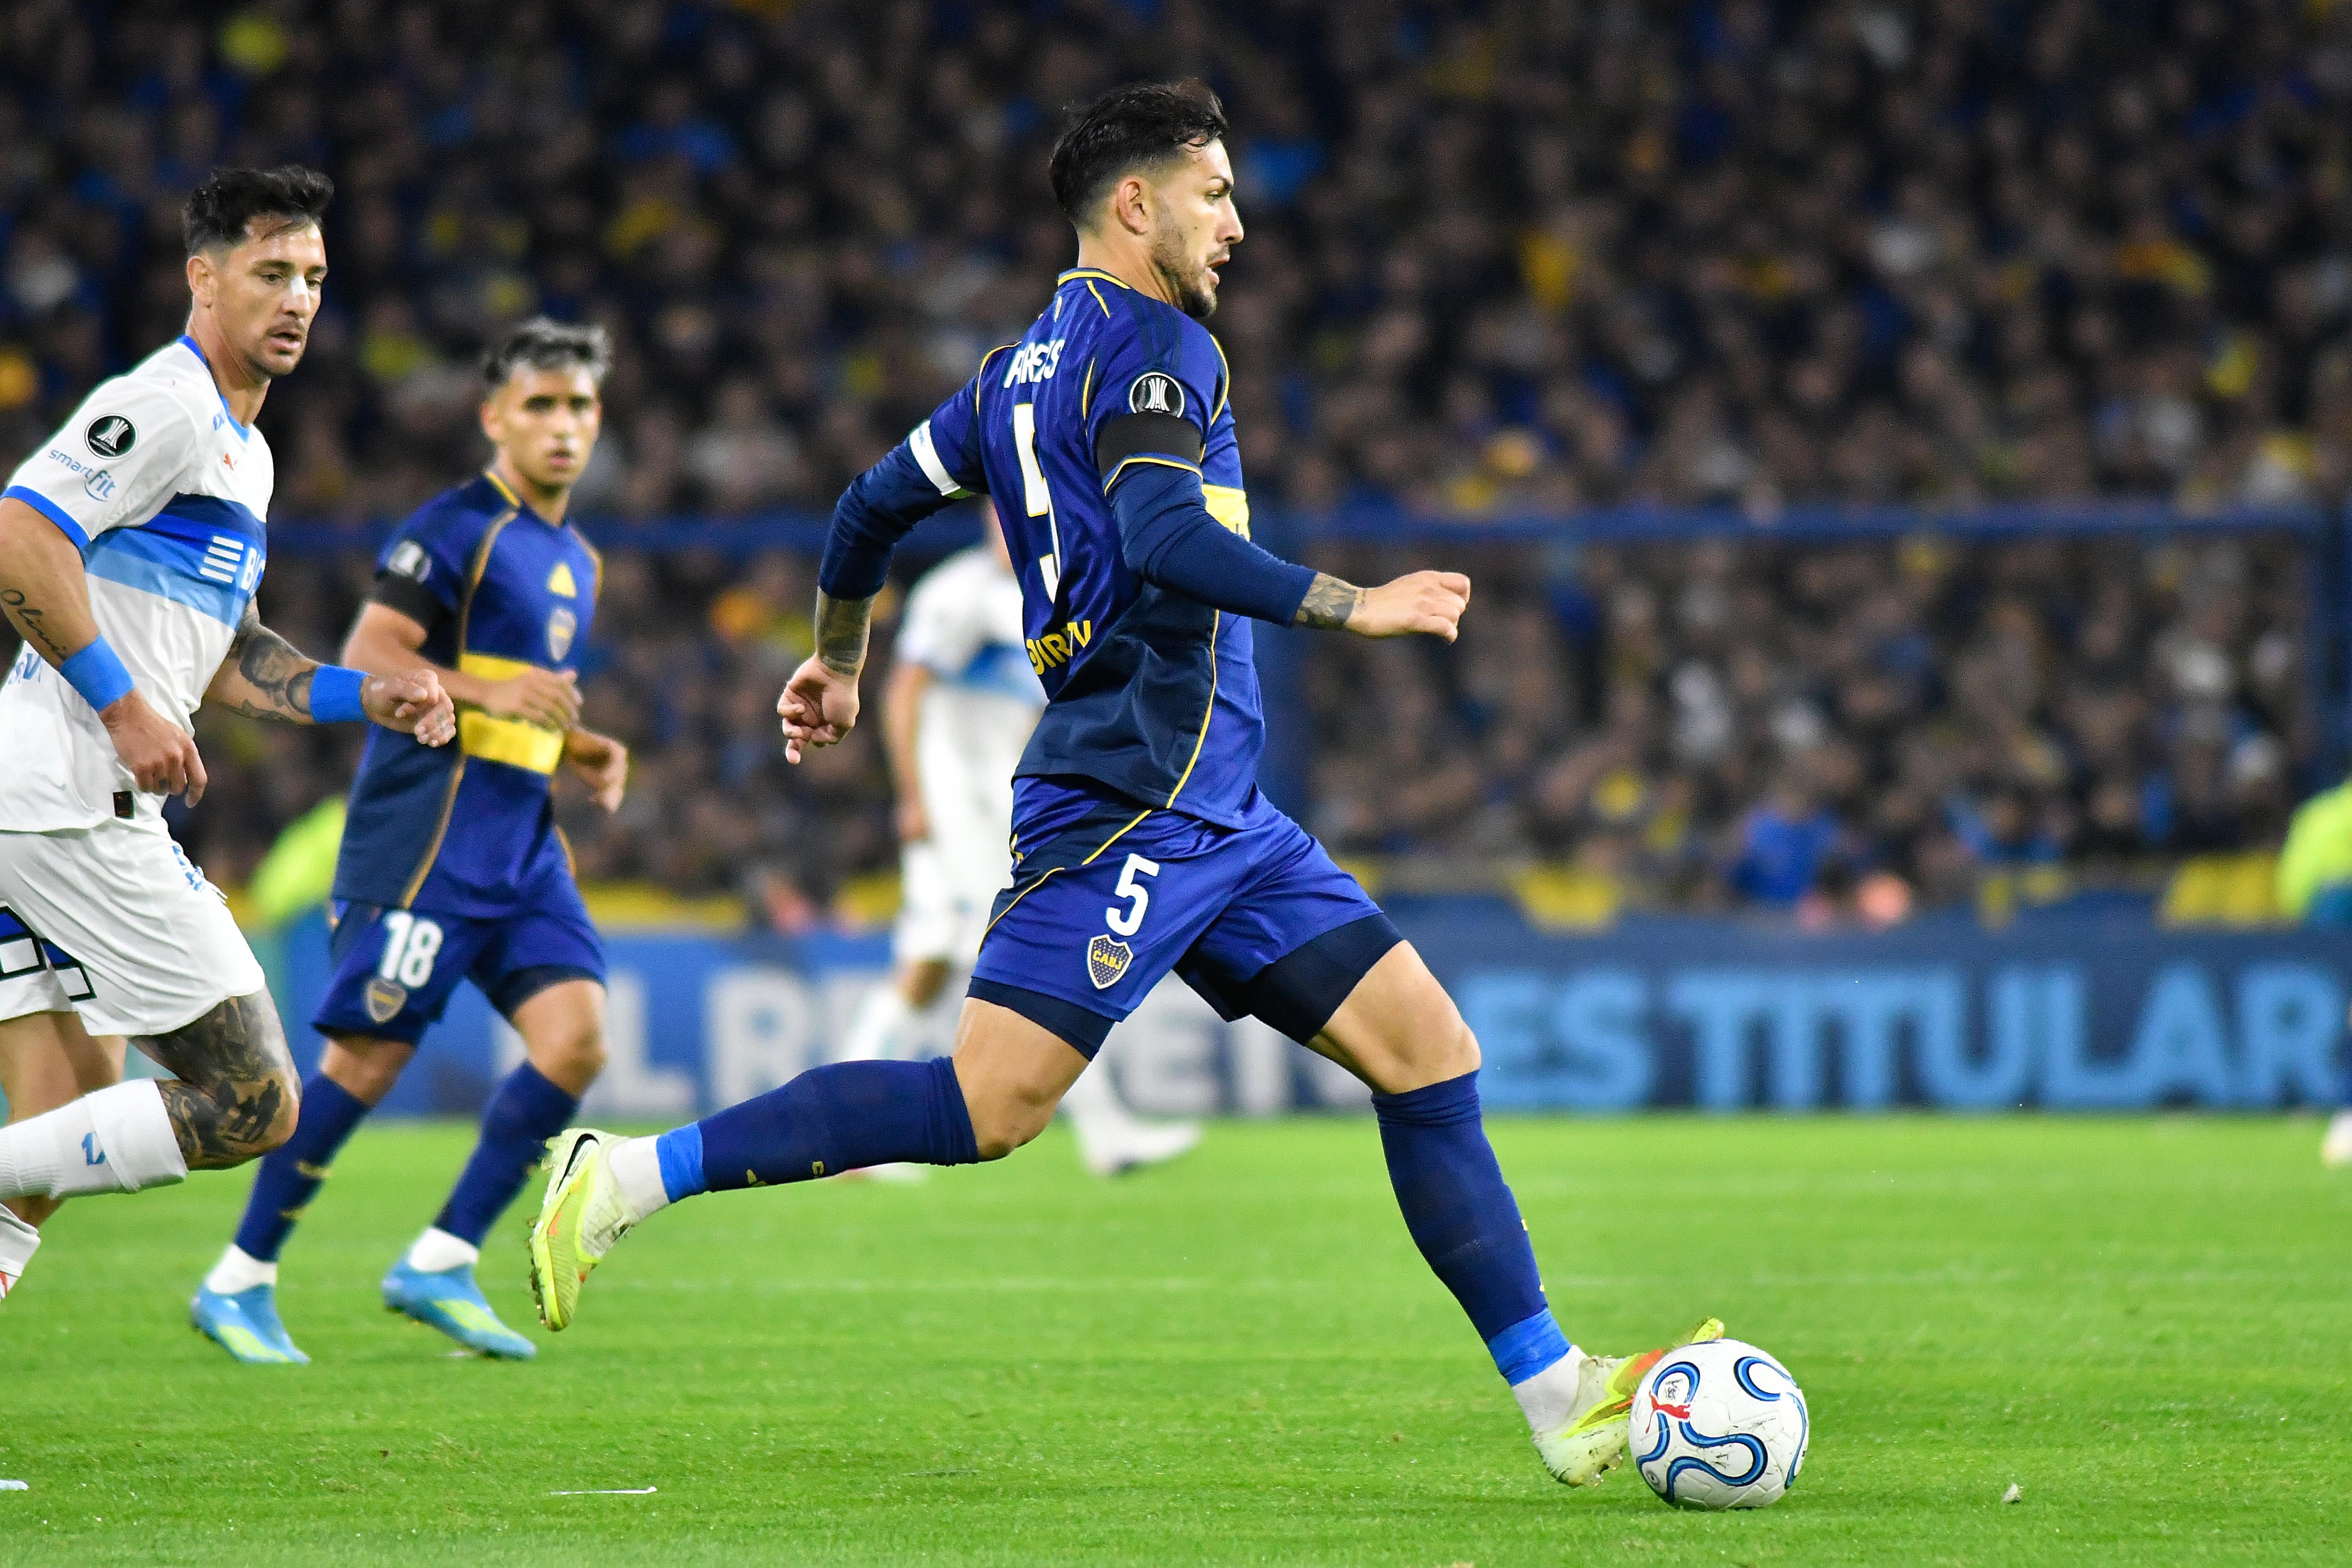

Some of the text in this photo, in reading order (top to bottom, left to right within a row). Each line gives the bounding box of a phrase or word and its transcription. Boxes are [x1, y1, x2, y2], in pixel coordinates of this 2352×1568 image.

[1106, 853, 1160, 936] 5
[381, 911, 444, 987] 18
[1093, 949, 1123, 970] CABJ
[1668, 967, 2350, 1111] TITULAR
